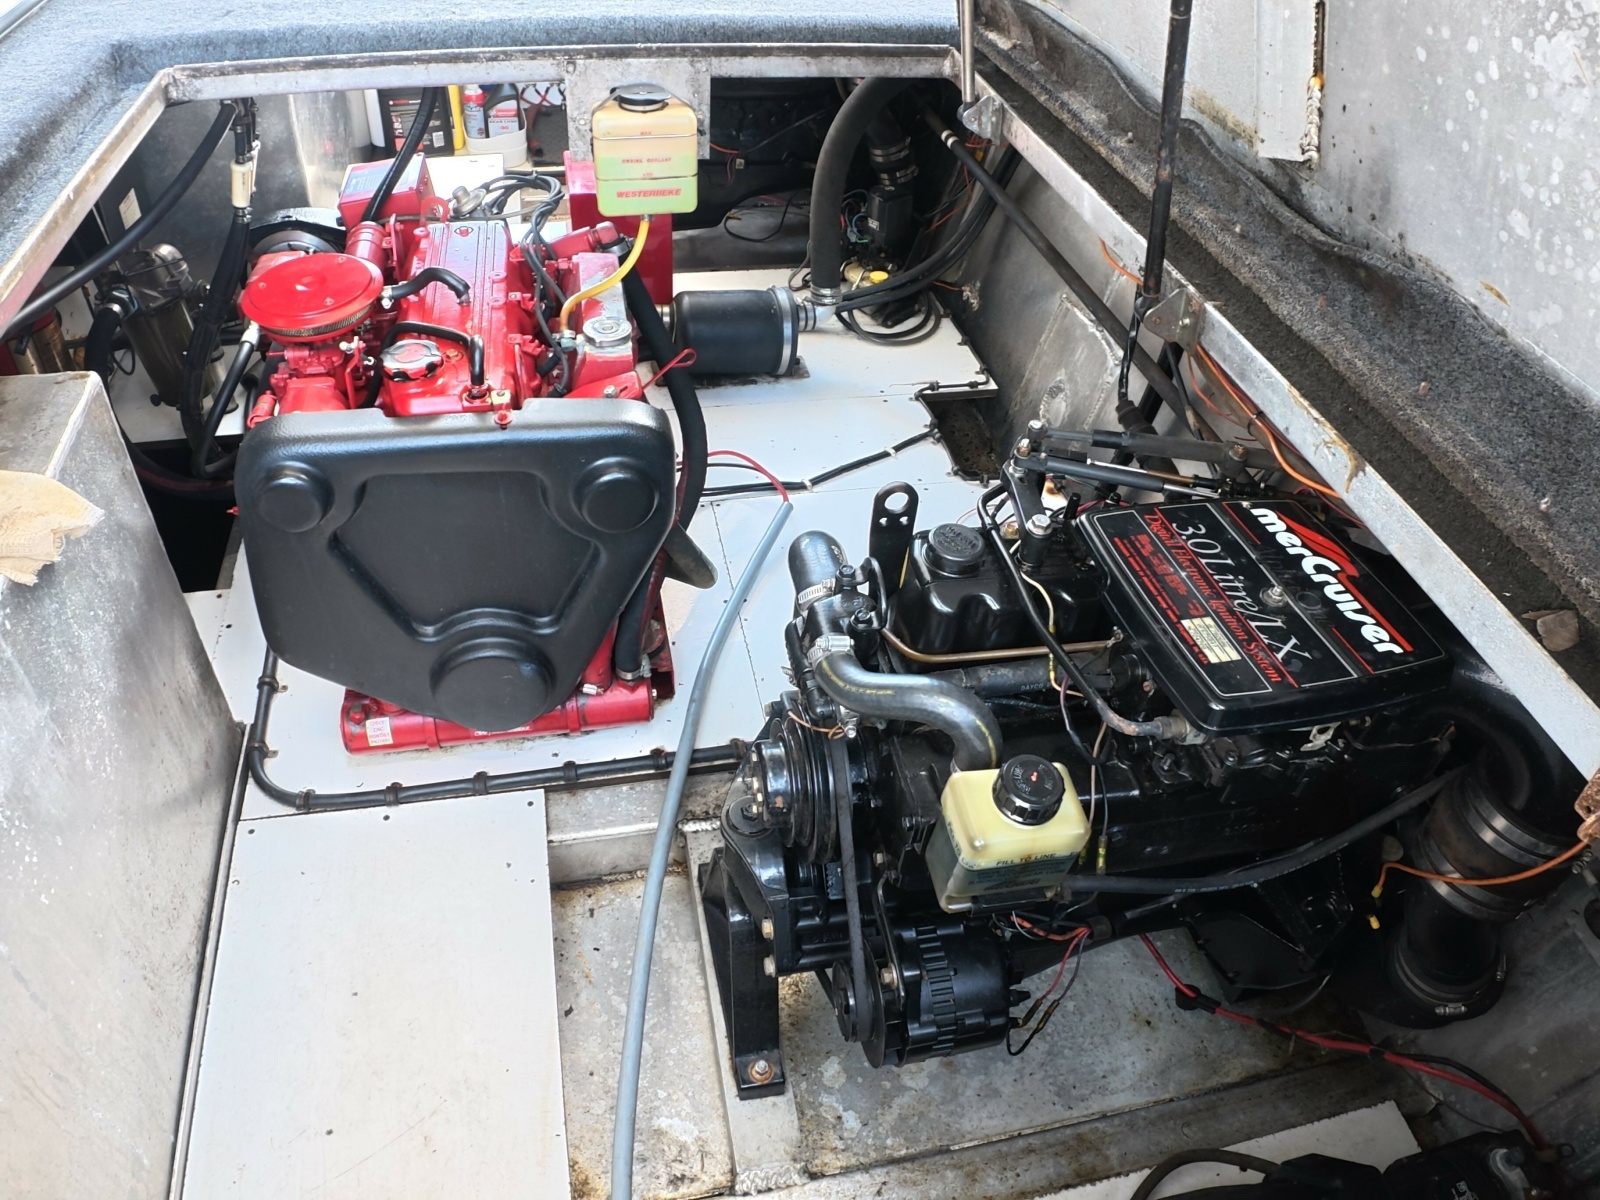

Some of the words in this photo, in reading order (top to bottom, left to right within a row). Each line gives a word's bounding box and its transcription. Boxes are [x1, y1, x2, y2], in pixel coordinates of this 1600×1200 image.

[616, 188, 681, 199] WESTERBEKE
[1143, 513, 1184, 548] Digital
[1171, 549, 1217, 599] Electronic
[1208, 599, 1249, 640] Ignition
[1243, 641, 1282, 682] System
[1020, 682, 1044, 692] DAYCO
[1019, 855, 1032, 863] TO
[1034, 852, 1057, 861] LINE
